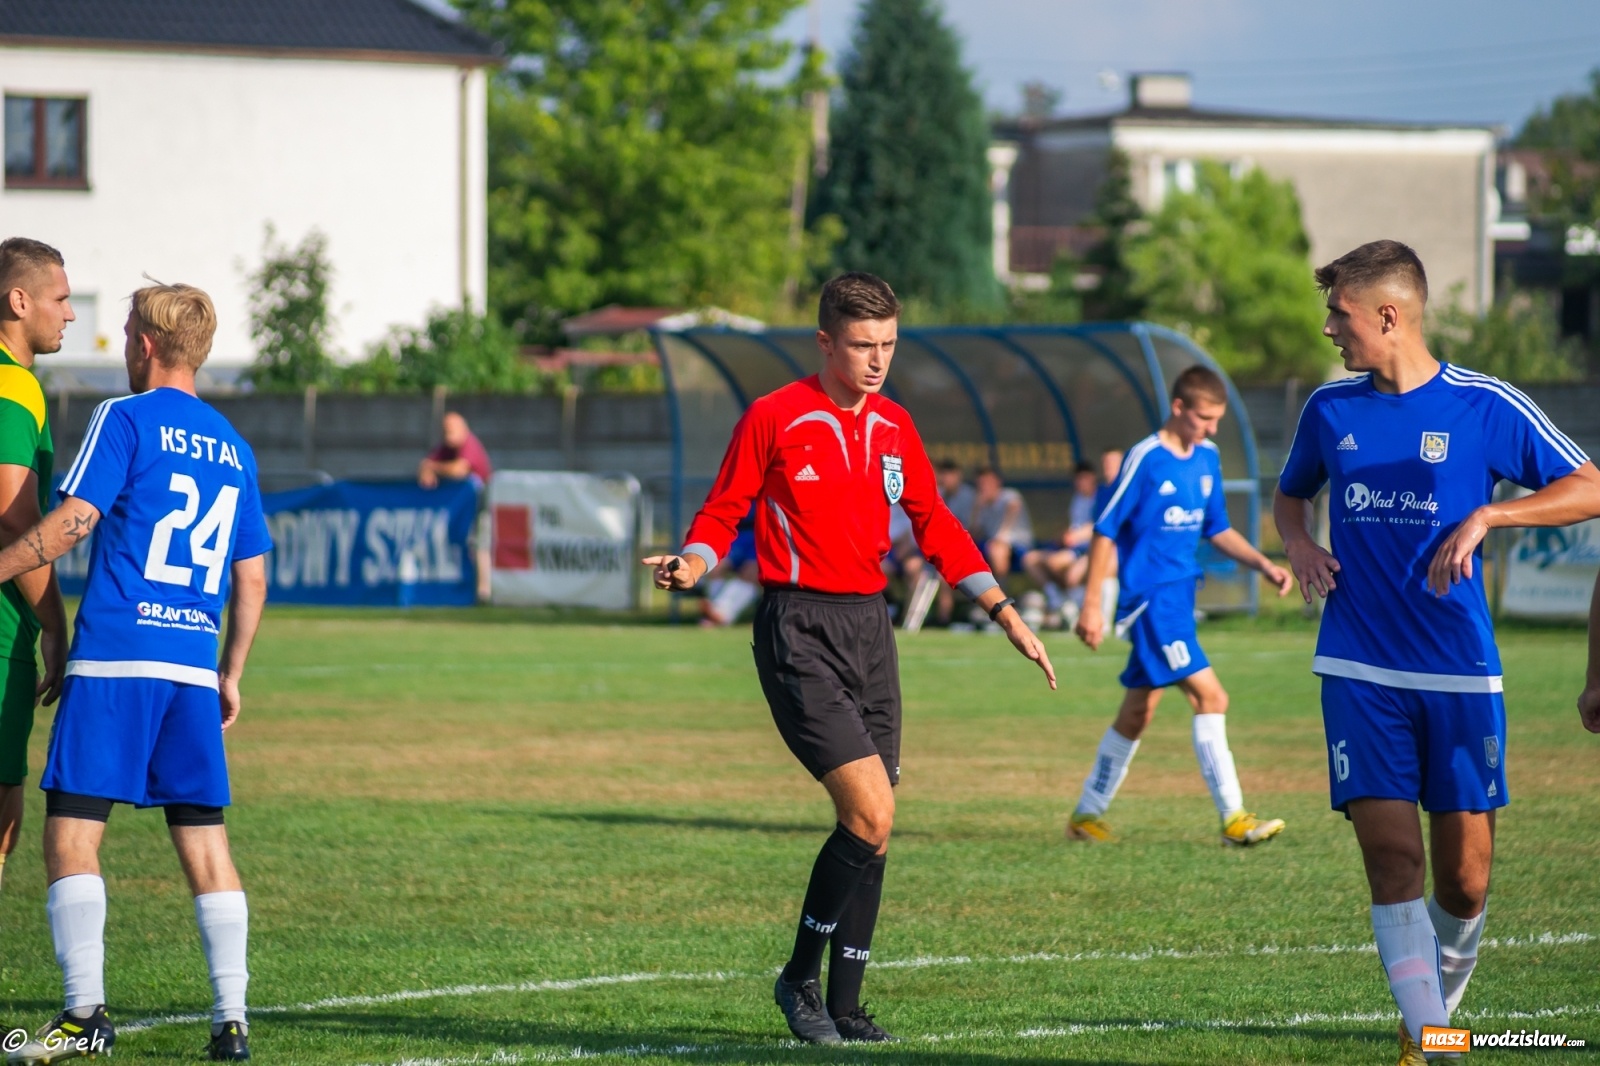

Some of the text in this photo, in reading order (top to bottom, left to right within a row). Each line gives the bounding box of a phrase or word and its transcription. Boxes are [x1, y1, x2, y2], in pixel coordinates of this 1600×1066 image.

[160, 426, 243, 471] KS STAL
[1370, 490, 1439, 514] Nad Rudą
[144, 472, 240, 595] 24
[1161, 639, 1191, 671] 10
[1332, 739, 1350, 783] 16
